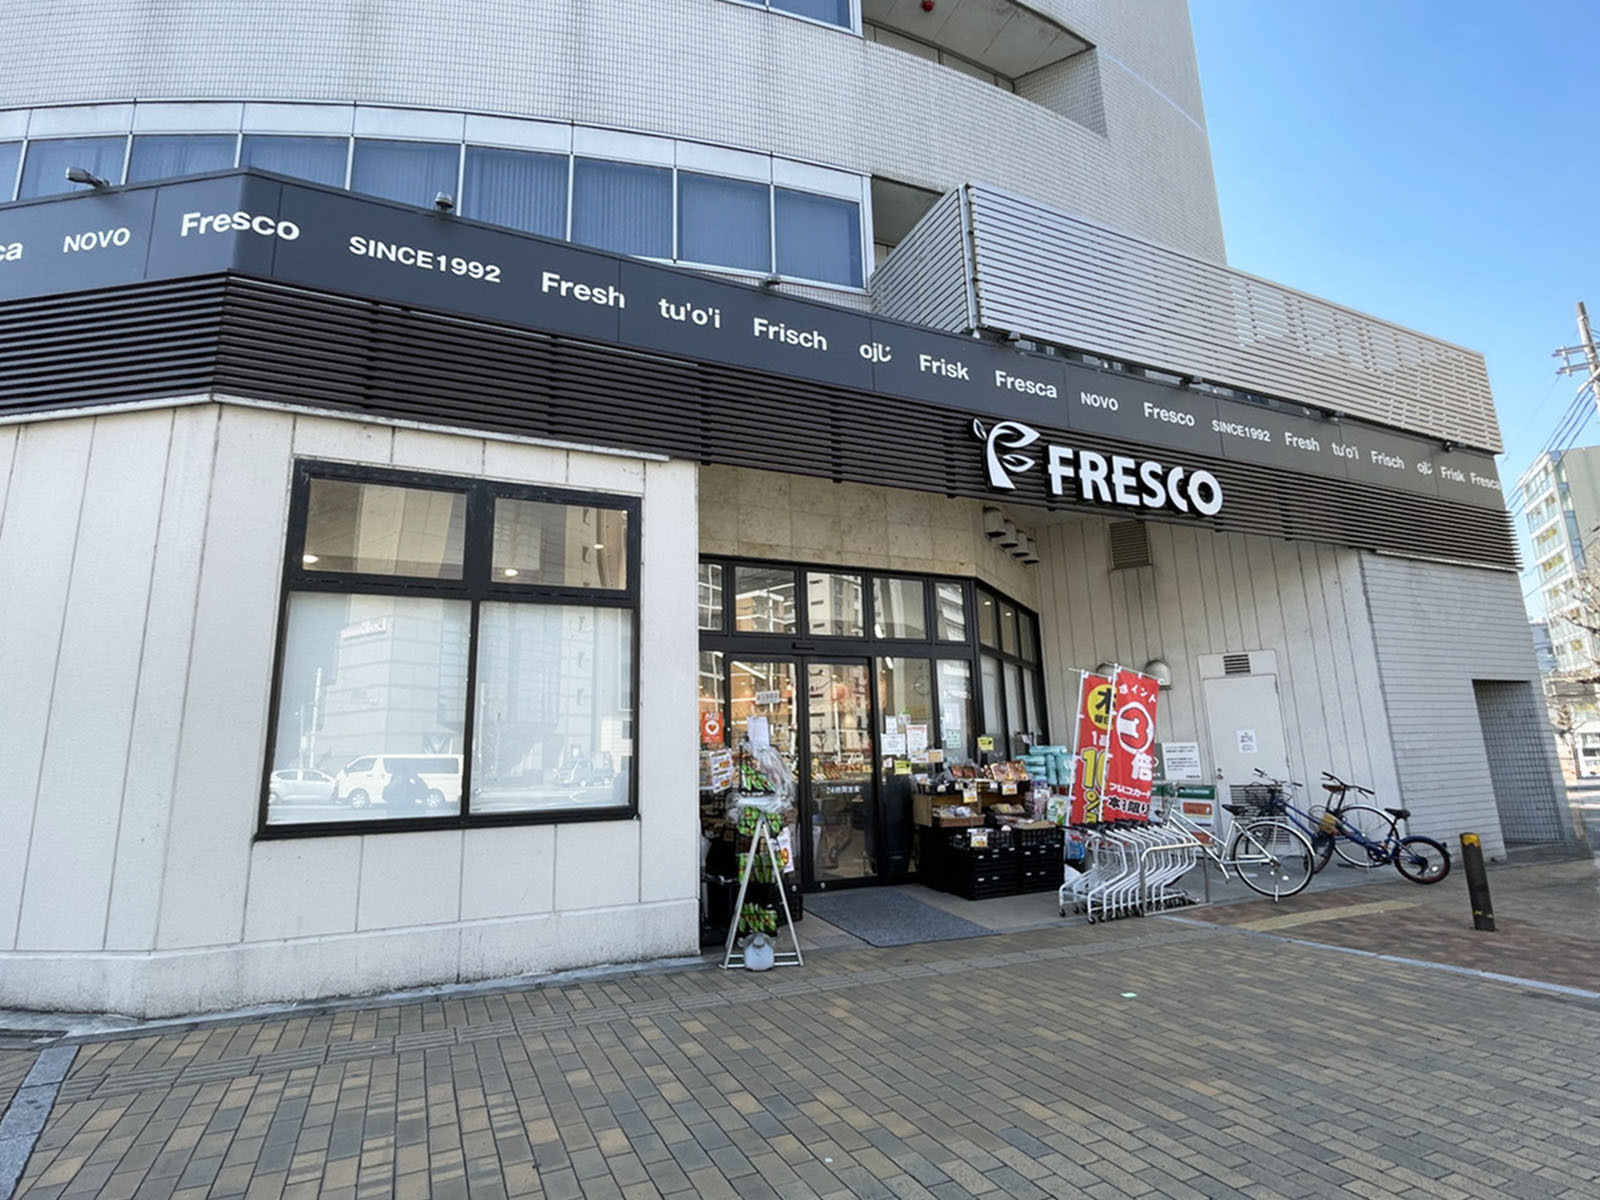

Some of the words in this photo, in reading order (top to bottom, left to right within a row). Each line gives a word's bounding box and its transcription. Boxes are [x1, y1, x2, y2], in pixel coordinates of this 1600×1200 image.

[63, 227, 131, 253] NOVO
[180, 211, 300, 241] Fresco
[349, 236, 502, 284] SINCE1992
[541, 271, 626, 309] Fresh
[753, 317, 828, 351] Frisch
[919, 354, 970, 381] Frisk
[995, 369, 1058, 399] Fresca
[1080, 391, 1119, 411] NOVO
[1143, 401, 1195, 427] Fresco
[1211, 419, 1271, 442] SINCE1992
[1284, 431, 1320, 452] Fresh
[1370, 450, 1405, 469] Frisch
[1440, 466, 1466, 482] Frisk
[1048, 444, 1223, 516] FRESCO
